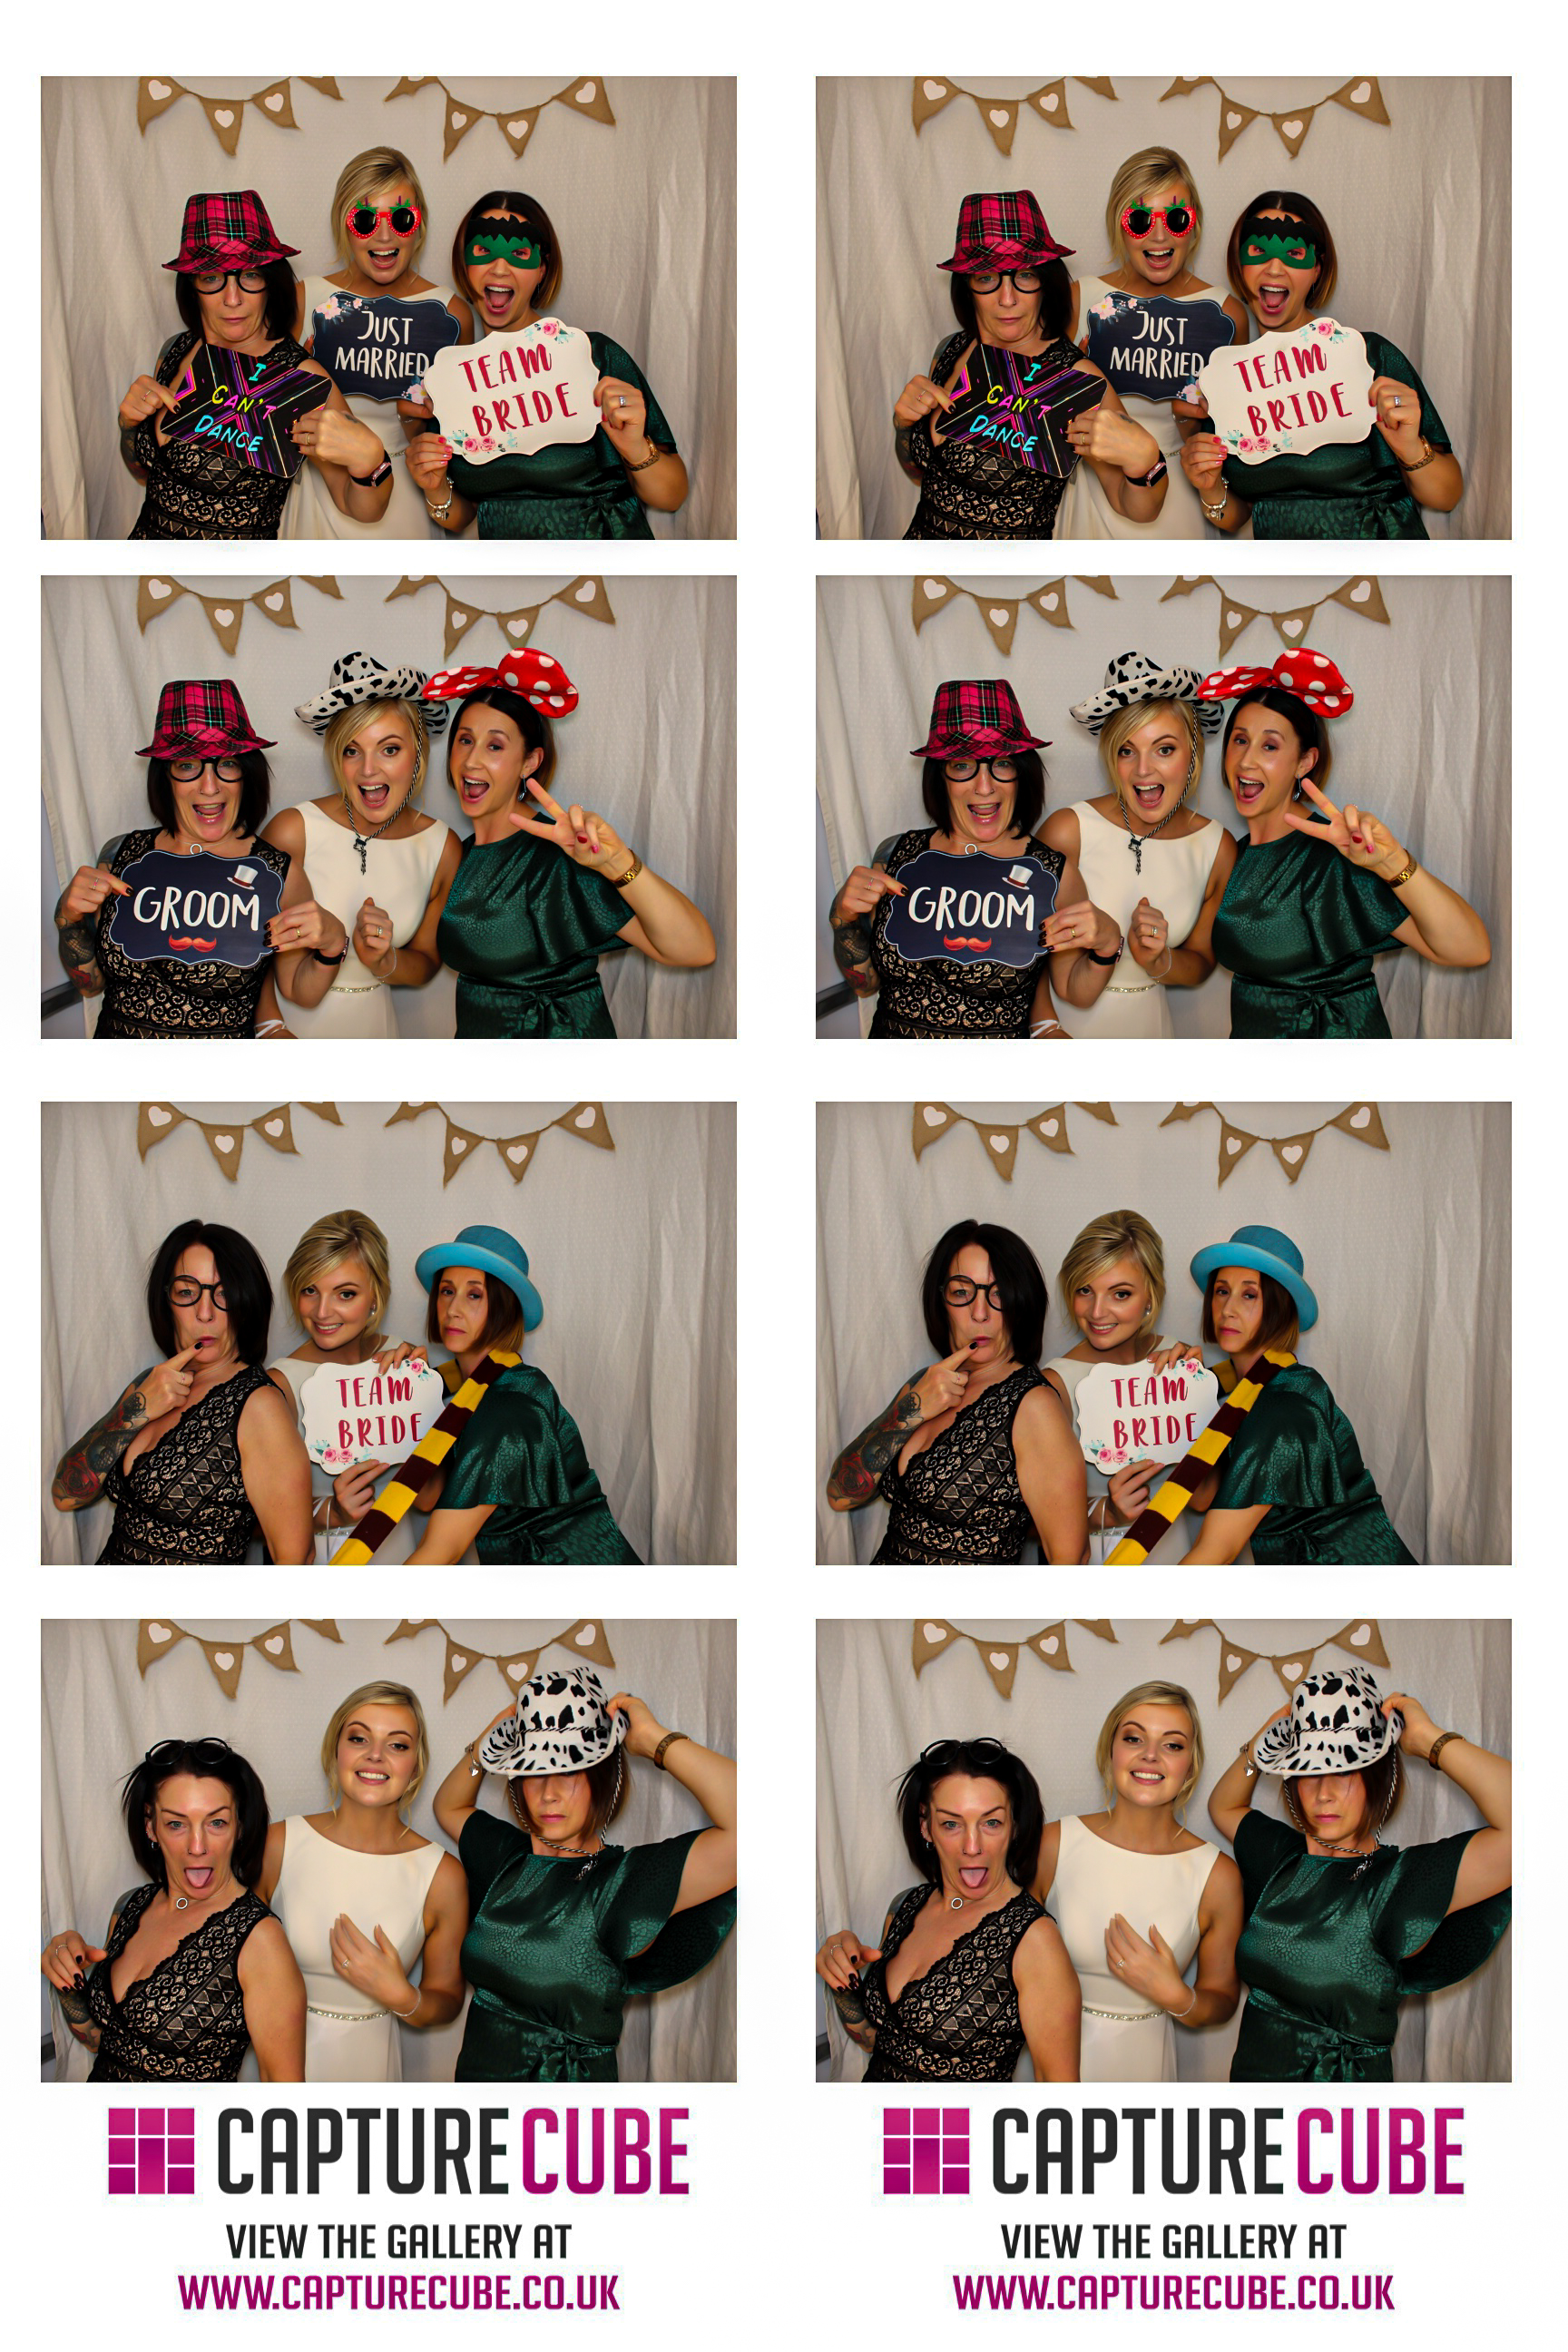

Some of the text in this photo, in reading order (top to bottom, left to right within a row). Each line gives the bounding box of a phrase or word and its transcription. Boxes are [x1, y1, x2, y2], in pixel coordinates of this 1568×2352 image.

[357, 310, 414, 346] JUST
[1132, 310, 1189, 346] JUST
[248, 363, 267, 381] I
[335, 346, 430, 379] MARRIED
[457, 343, 553, 393] TEAM
[1023, 363, 1042, 381] I
[1110, 346, 1205, 379] MARRIED
[1232, 343, 1328, 393] TEAM
[211, 385, 277, 420] CAN'T
[472, 382, 578, 437] BRIDE
[986, 385, 1052, 420] CAN'T
[1247, 382, 1353, 437] BRIDE
[194, 415, 263, 452] DANCE
[969, 415, 1038, 452] DANCE
[133, 886, 260, 931] GROOM
[908, 886, 1034, 931] GROOM
[335, 1376, 414, 1408] TEAM
[1110, 1376, 1189, 1408] TEAM
[338, 1412, 423, 1450] BRIDE
[1112, 1412, 1198, 1450] BRIDE
